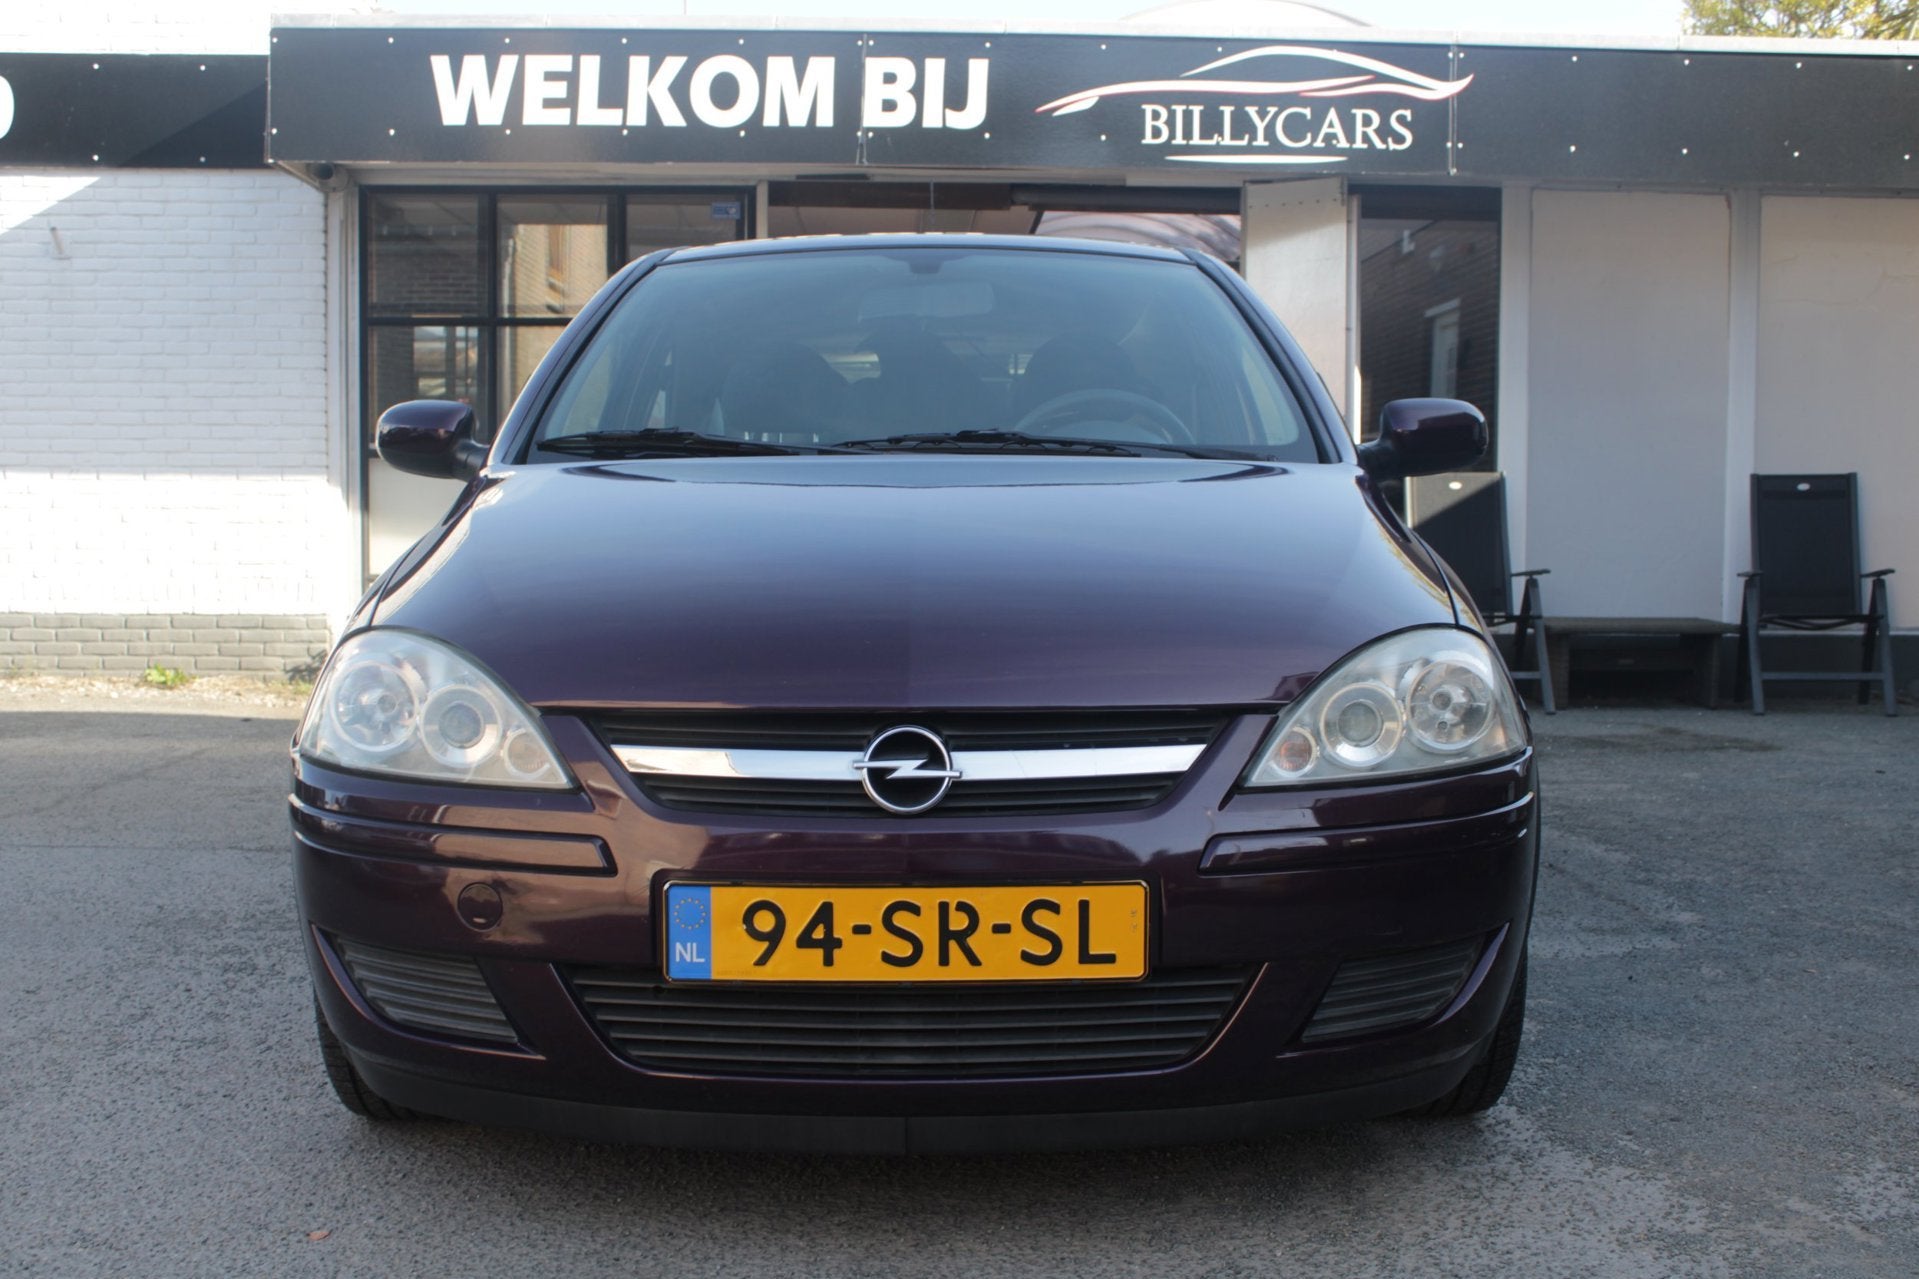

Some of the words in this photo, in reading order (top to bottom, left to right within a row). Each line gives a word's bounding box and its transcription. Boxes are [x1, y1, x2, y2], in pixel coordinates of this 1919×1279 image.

[429, 54, 836, 128] WELKOM
[862, 55, 990, 129] BIJ
[1140, 104, 1413, 151] BILLYCARS
[675, 942, 705, 962] NL
[741, 899, 1117, 967] 94-SR-SL
